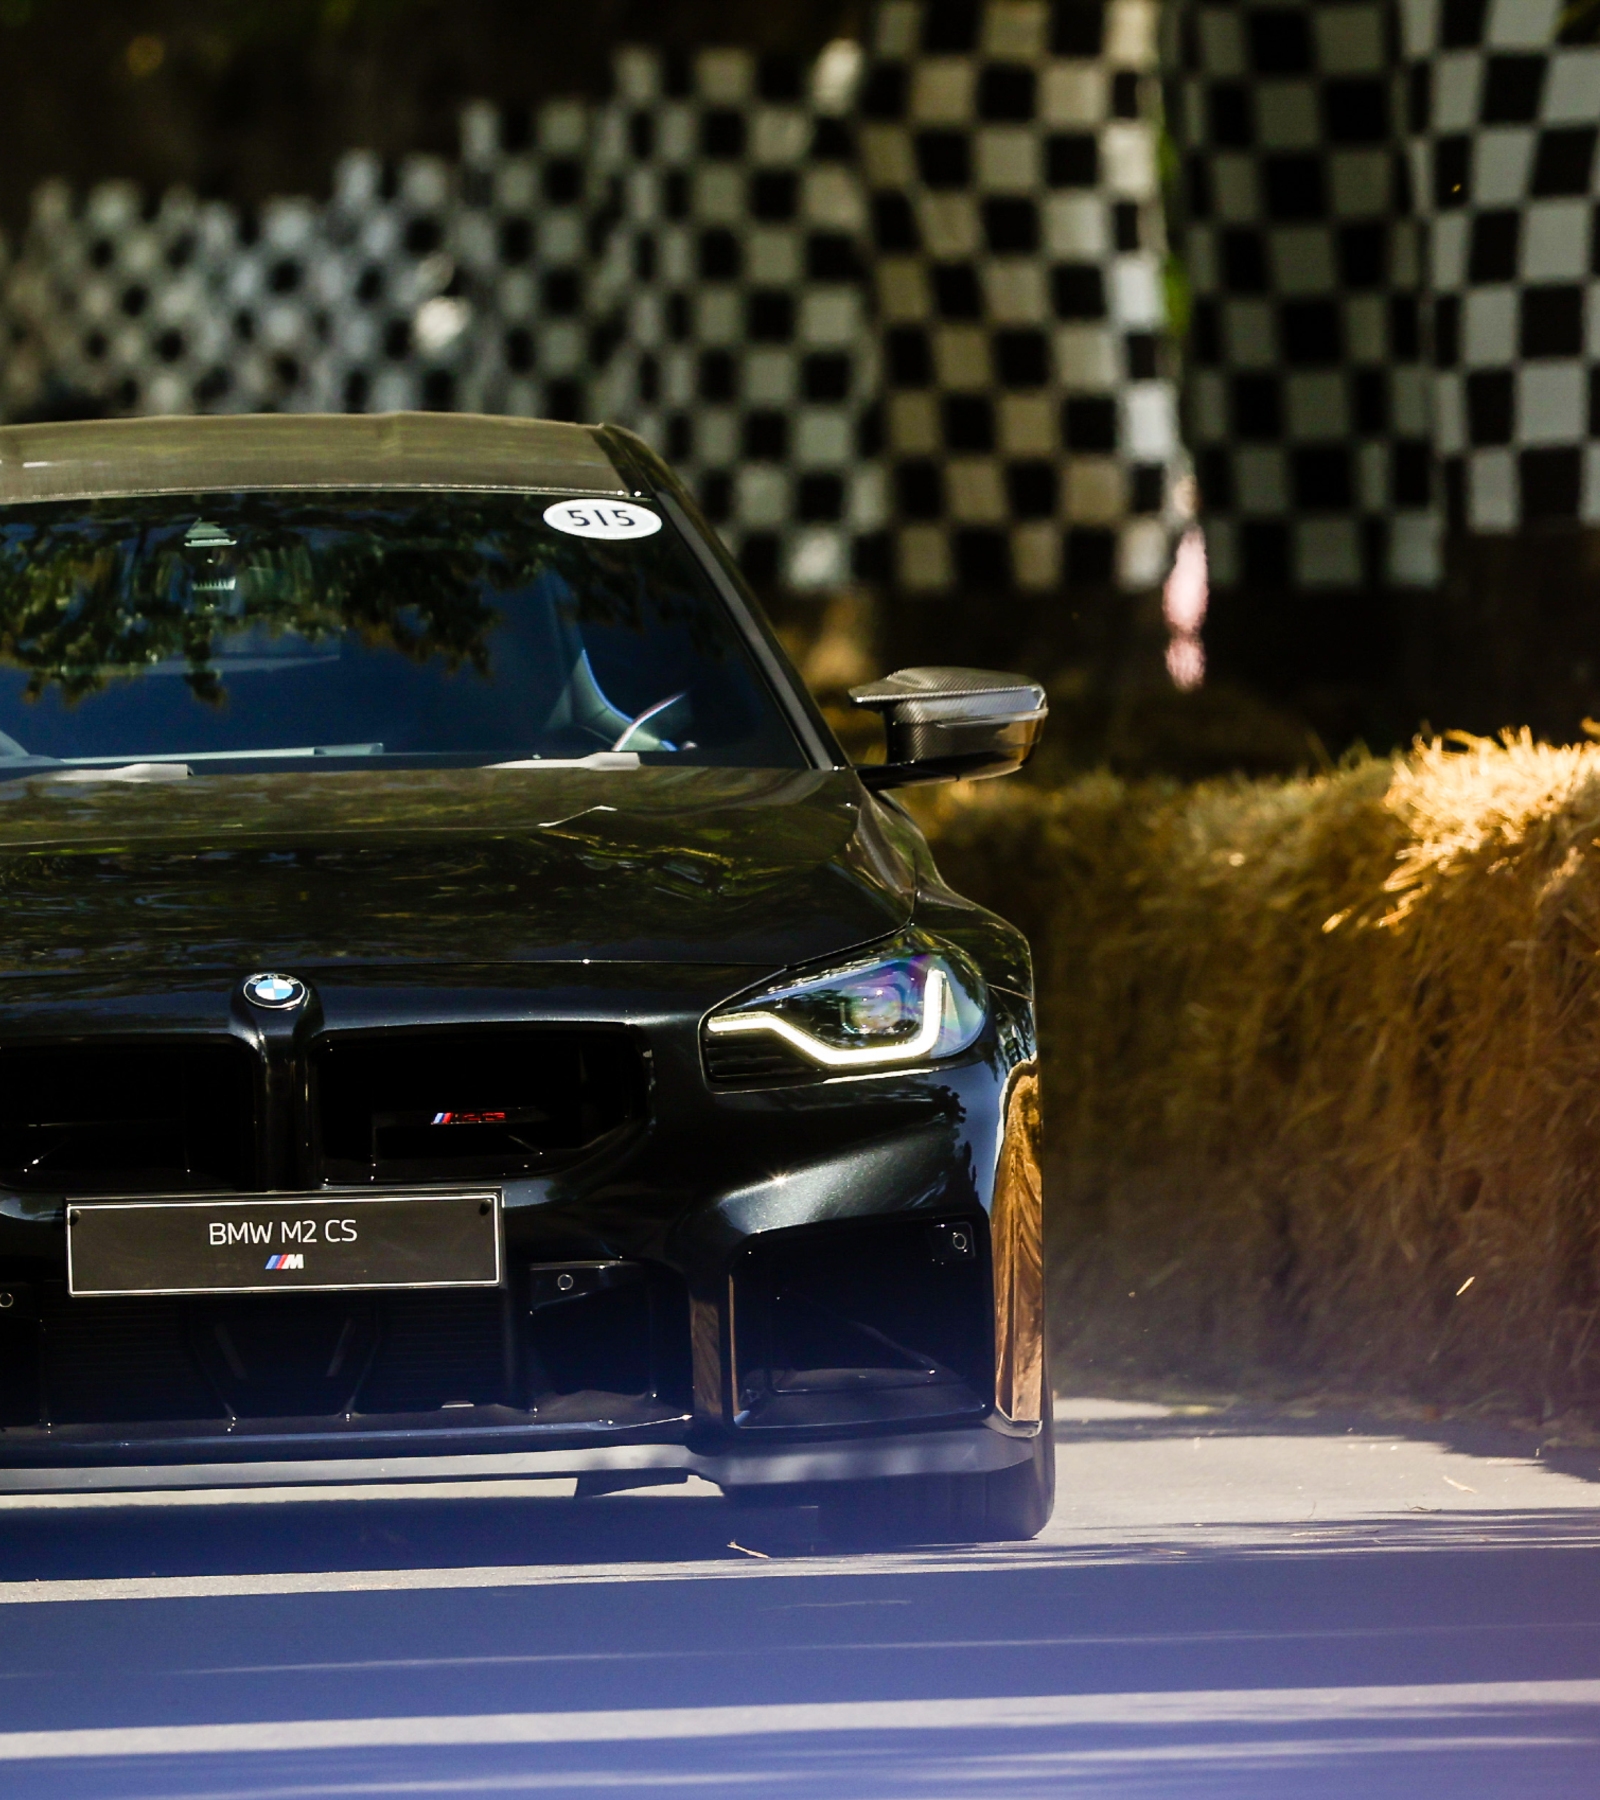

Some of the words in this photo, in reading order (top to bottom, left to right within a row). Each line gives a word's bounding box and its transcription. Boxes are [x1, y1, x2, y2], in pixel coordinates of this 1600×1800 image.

[567, 509, 636, 528] 515
[208, 1221, 274, 1246] BMW
[280, 1219, 318, 1244] M2
[324, 1219, 358, 1243] CS
